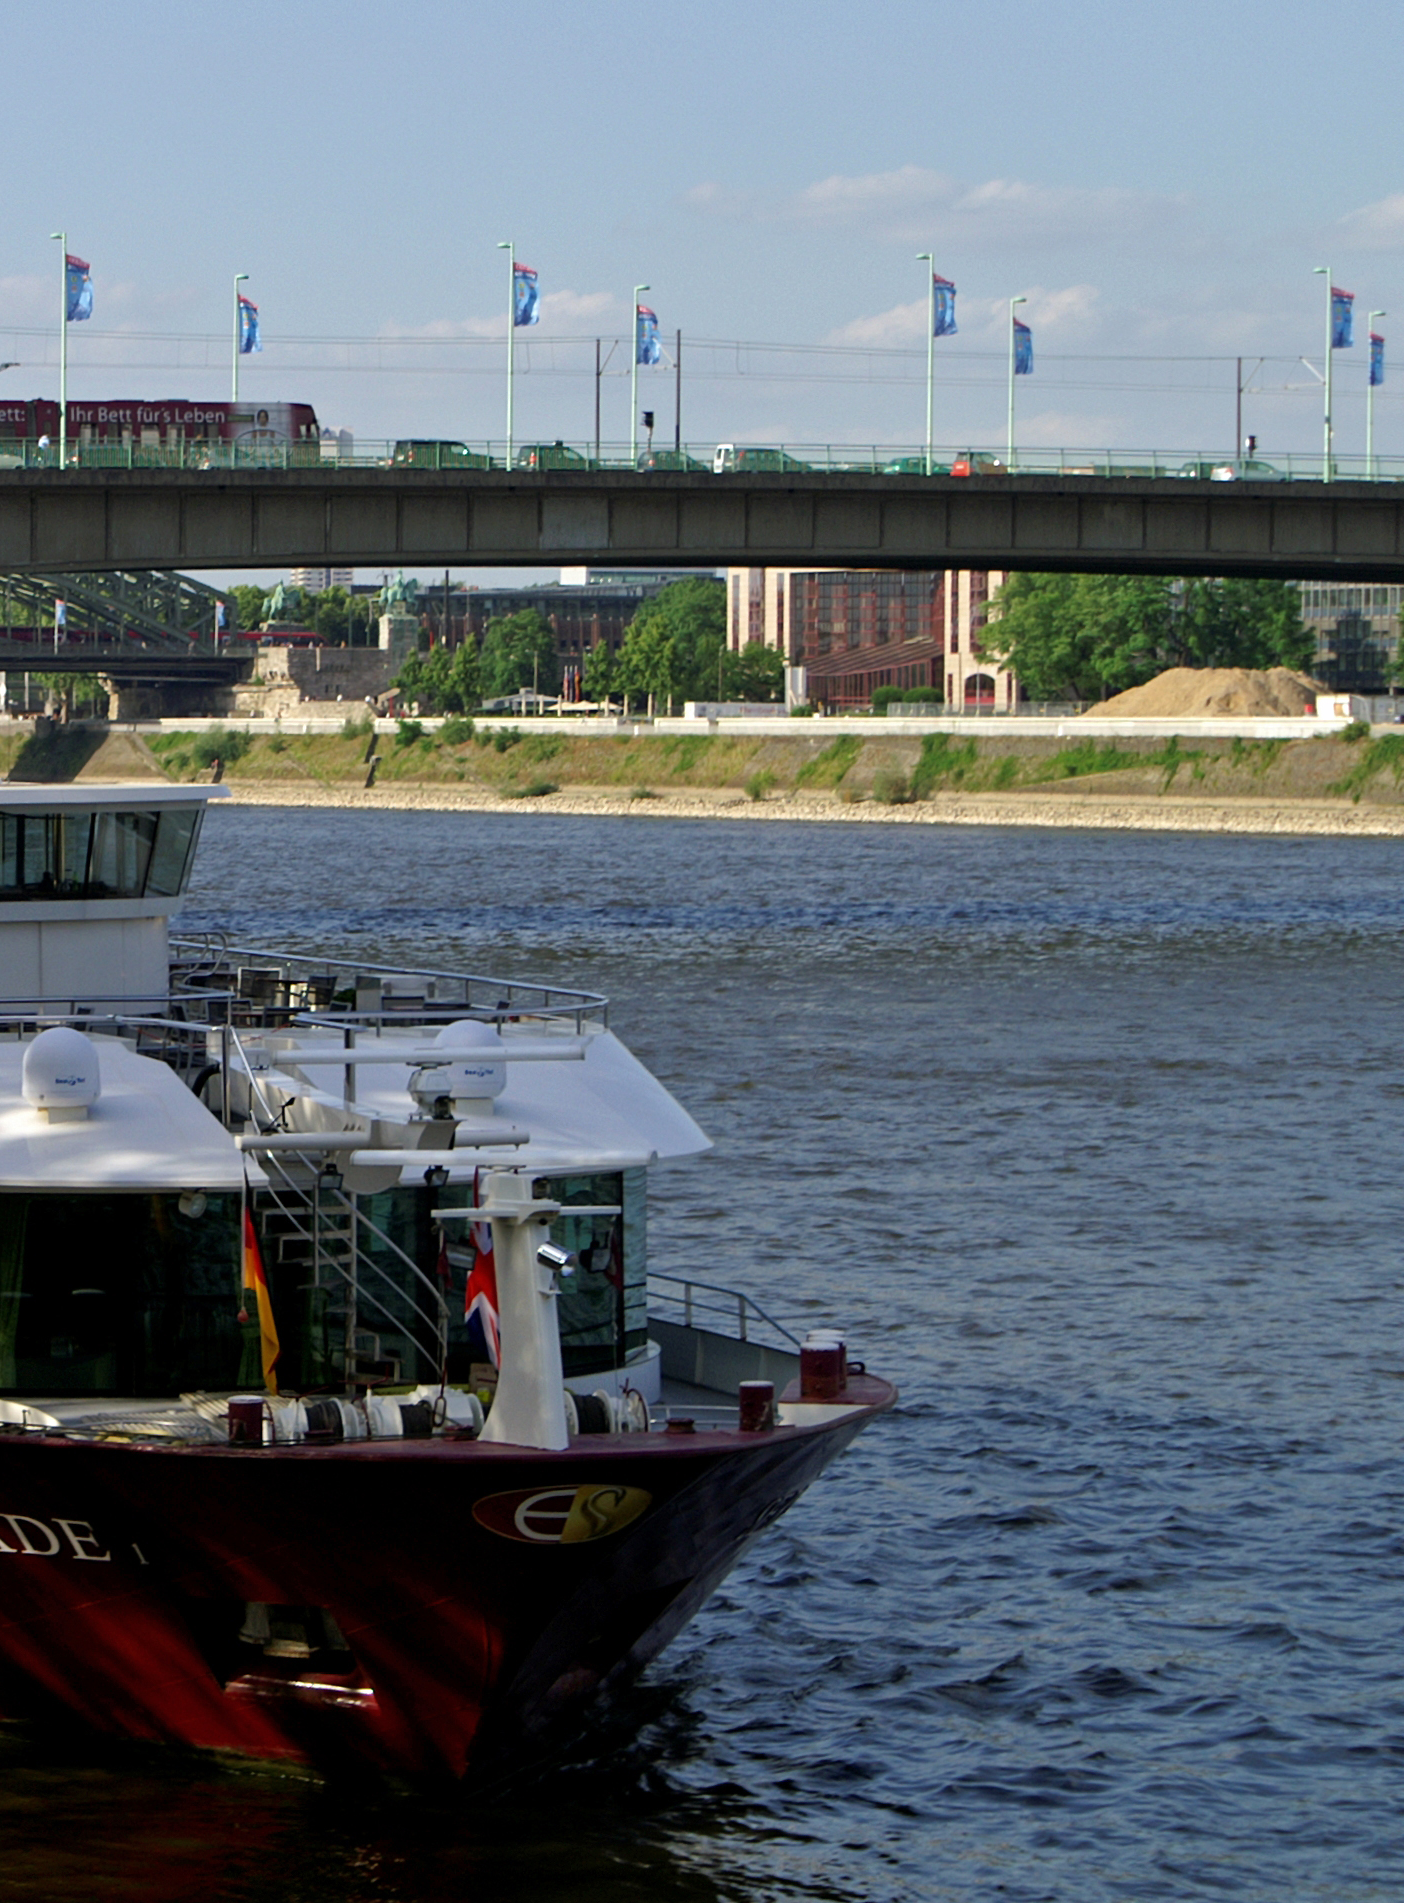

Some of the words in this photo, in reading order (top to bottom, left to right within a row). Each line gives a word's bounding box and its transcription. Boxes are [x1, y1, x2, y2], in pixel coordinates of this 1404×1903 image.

[70, 406, 93, 423] Ihr
[98, 407, 132, 423] Bett
[175, 407, 225, 423] Leben
